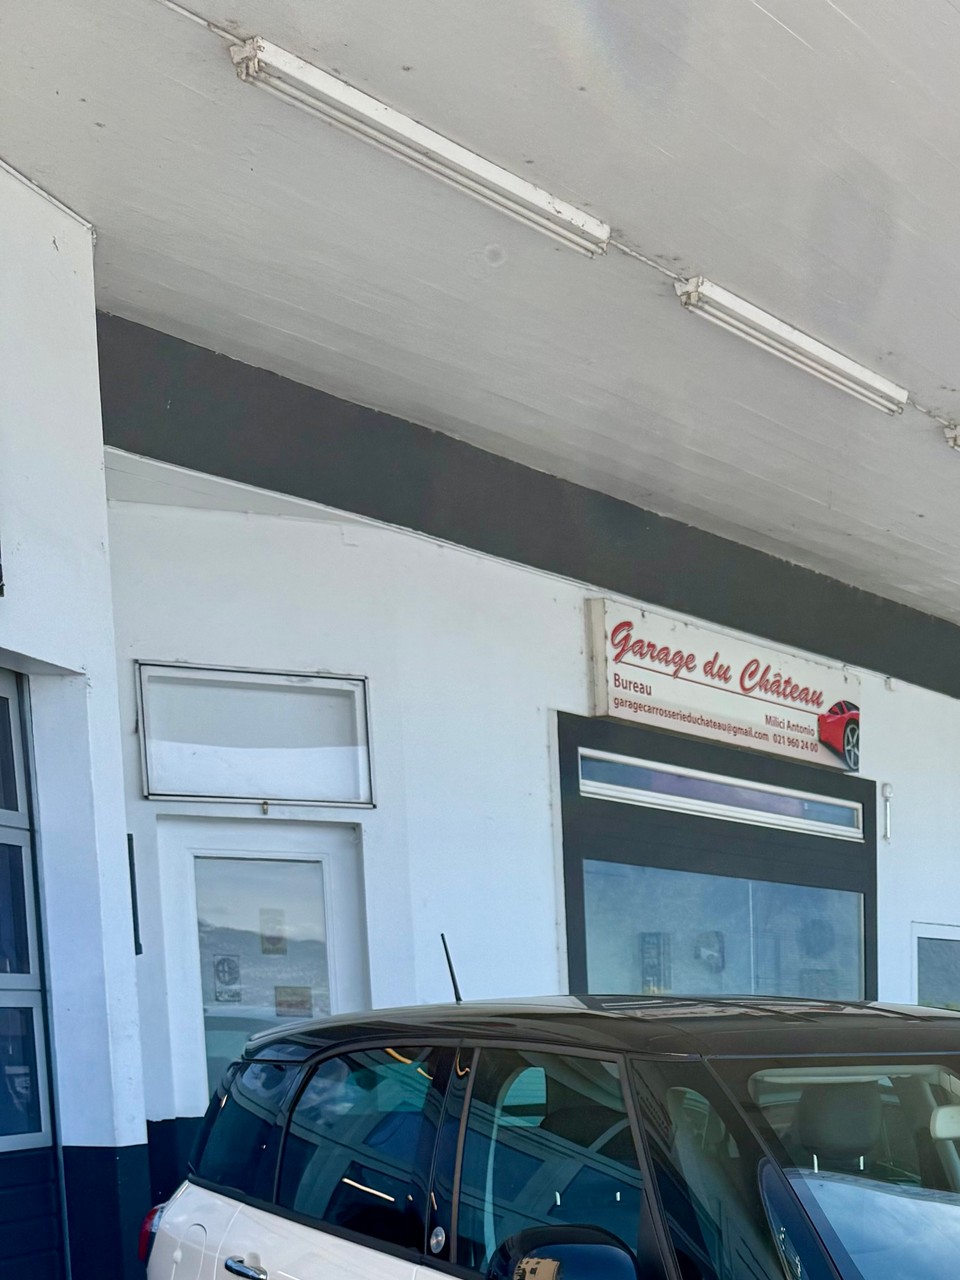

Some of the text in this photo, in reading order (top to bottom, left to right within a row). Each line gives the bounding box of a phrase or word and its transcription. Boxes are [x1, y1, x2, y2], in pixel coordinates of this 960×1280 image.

[610, 620, 824, 709] Garage du Château
[613, 672, 652, 696] Bureau
[613, 696, 819, 753] garagecarrosserieduchateau@gmail.com 021 960 24 00
[786, 719, 815, 737] Antonio
